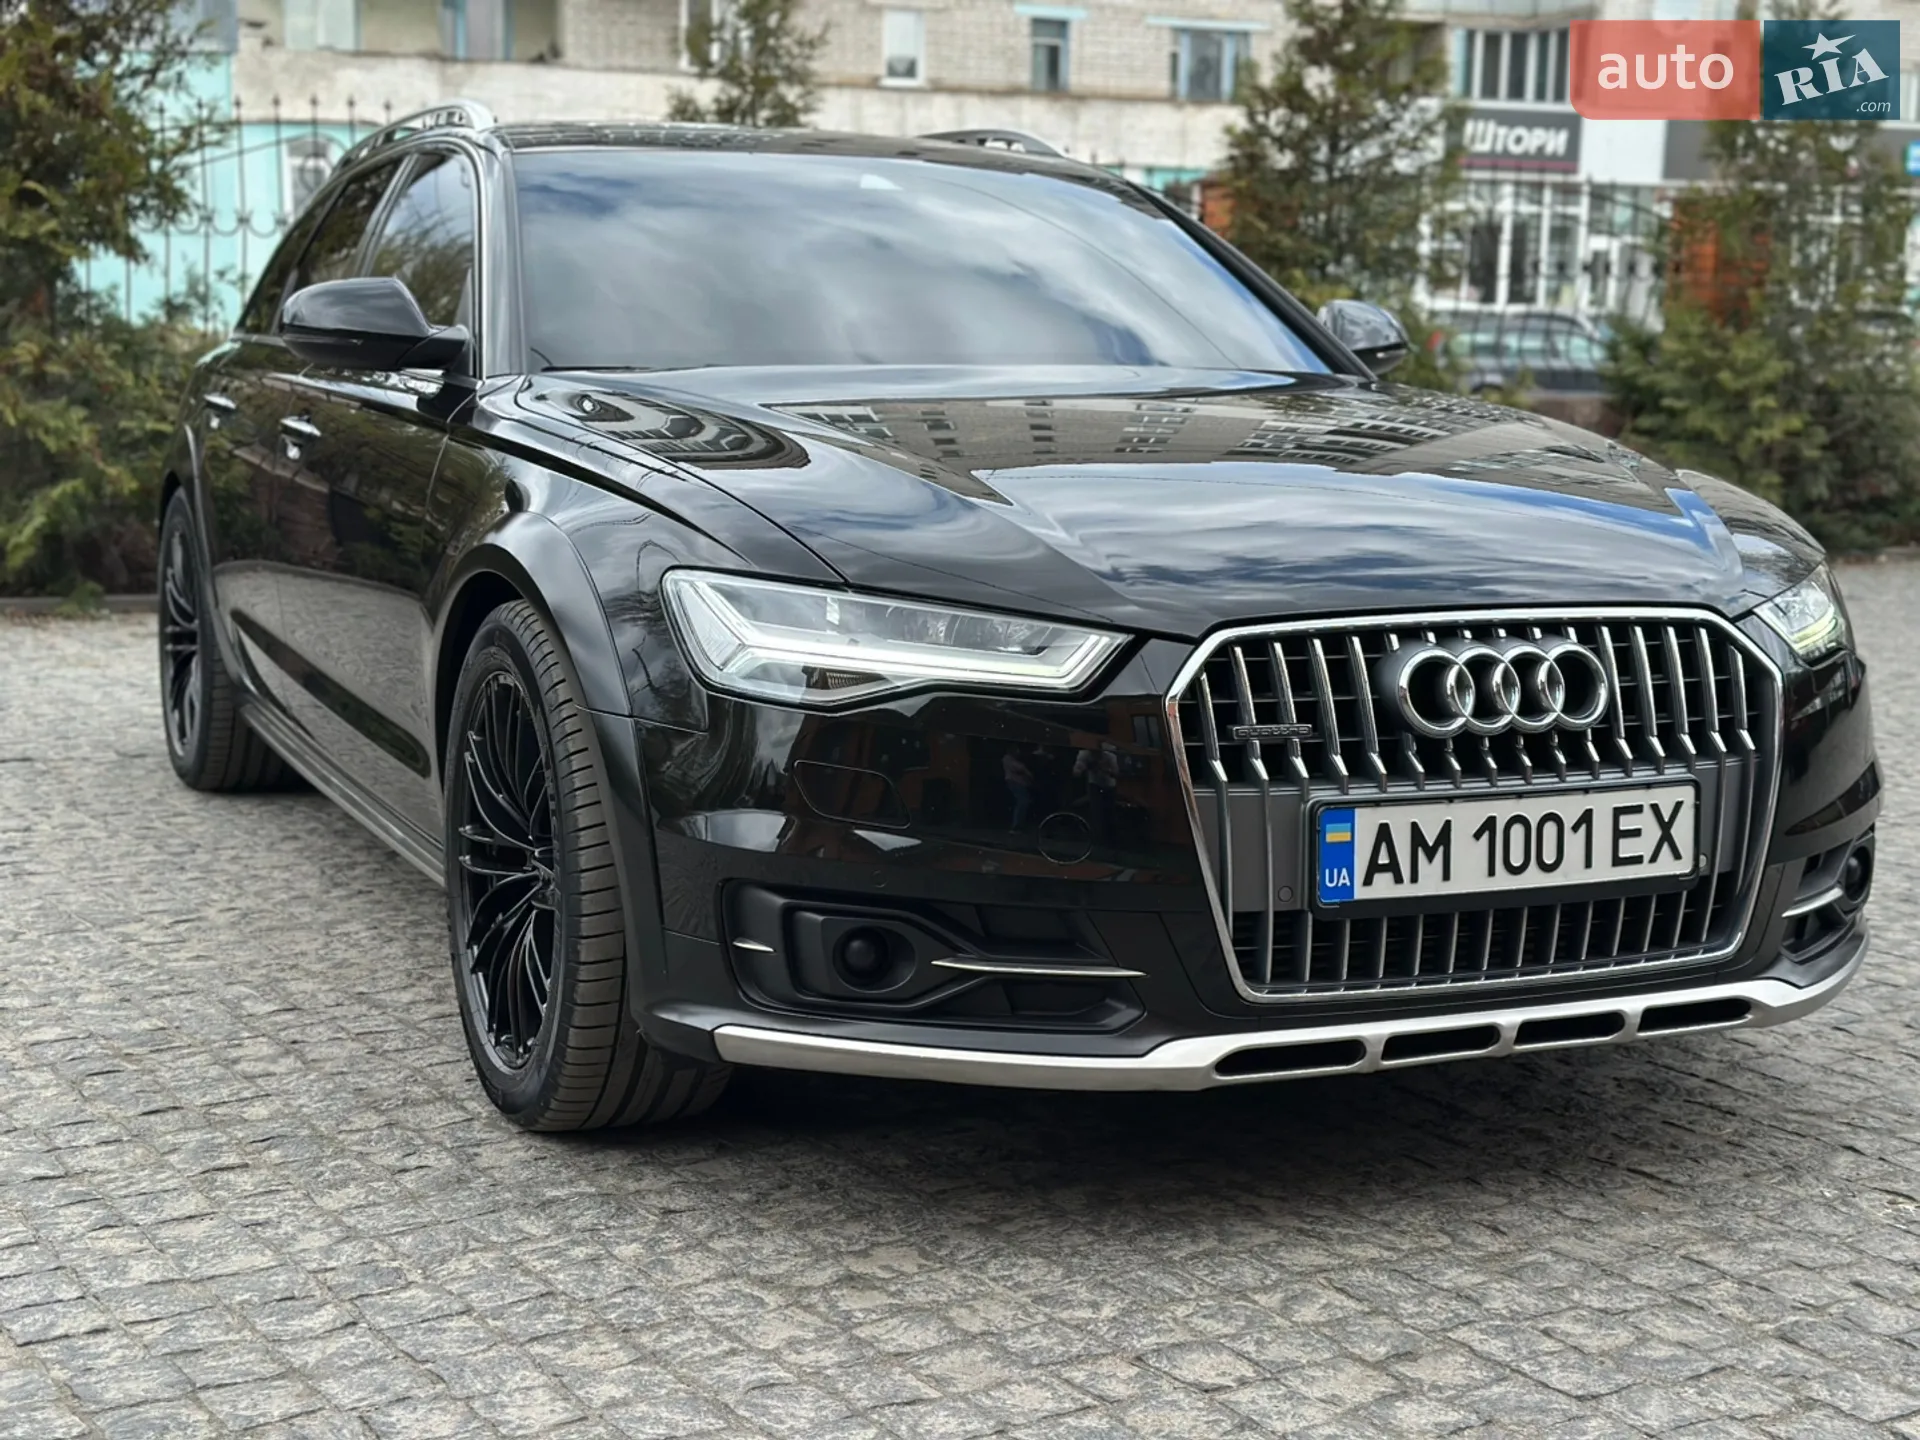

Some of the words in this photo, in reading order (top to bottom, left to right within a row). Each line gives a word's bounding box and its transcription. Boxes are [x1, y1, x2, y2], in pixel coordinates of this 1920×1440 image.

[1362, 818, 1452, 887] AM
[1472, 806, 1595, 878] 1001
[1611, 799, 1685, 867] EX
[1325, 867, 1351, 888] UA
